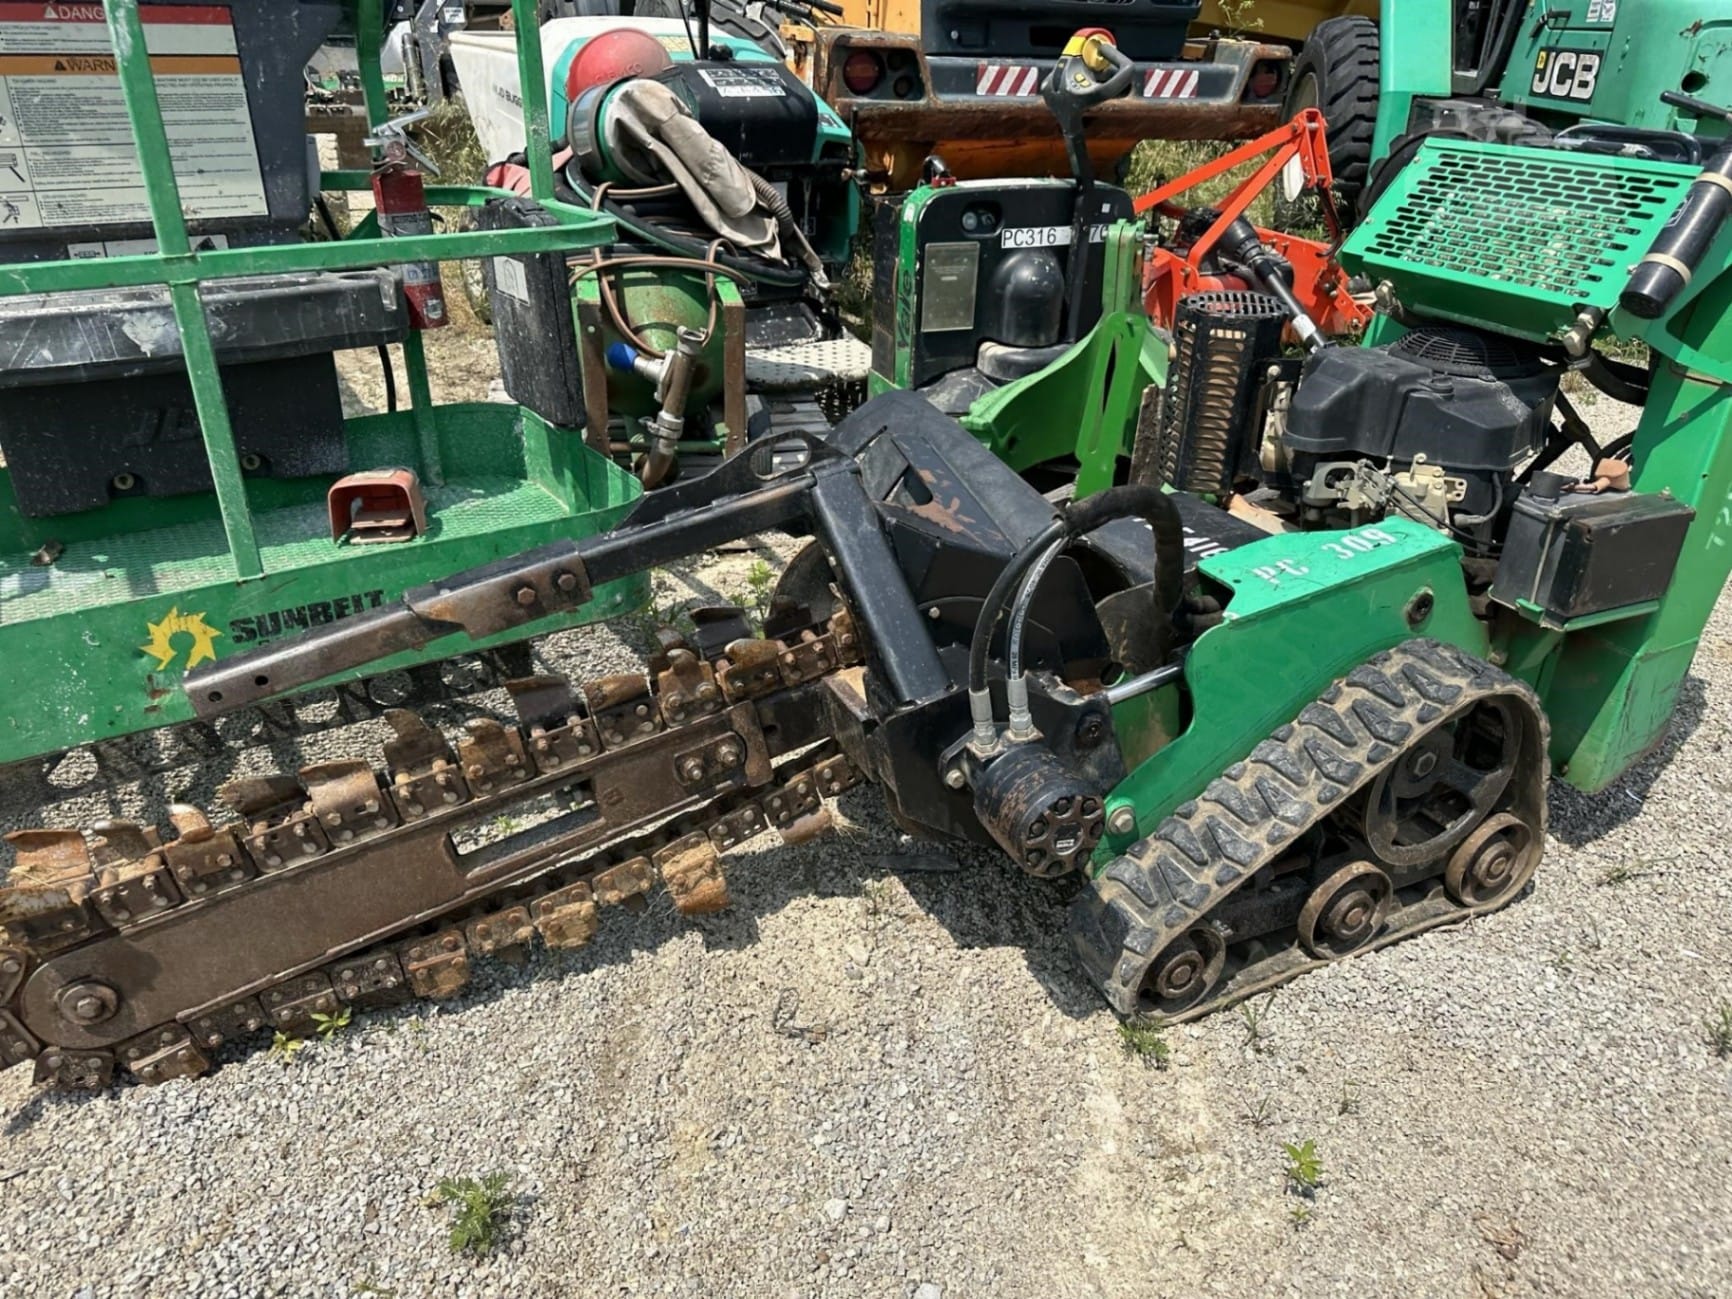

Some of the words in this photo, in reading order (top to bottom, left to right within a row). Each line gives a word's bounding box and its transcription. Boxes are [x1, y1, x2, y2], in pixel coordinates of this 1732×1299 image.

[58, 5, 105, 20] DANG
[67, 59, 116, 72] WARN
[1531, 50, 1601, 100] JCB
[1002, 227, 1057, 247] PC316
[1252, 558, 1309, 585] PC
[1321, 528, 1397, 560] 309
